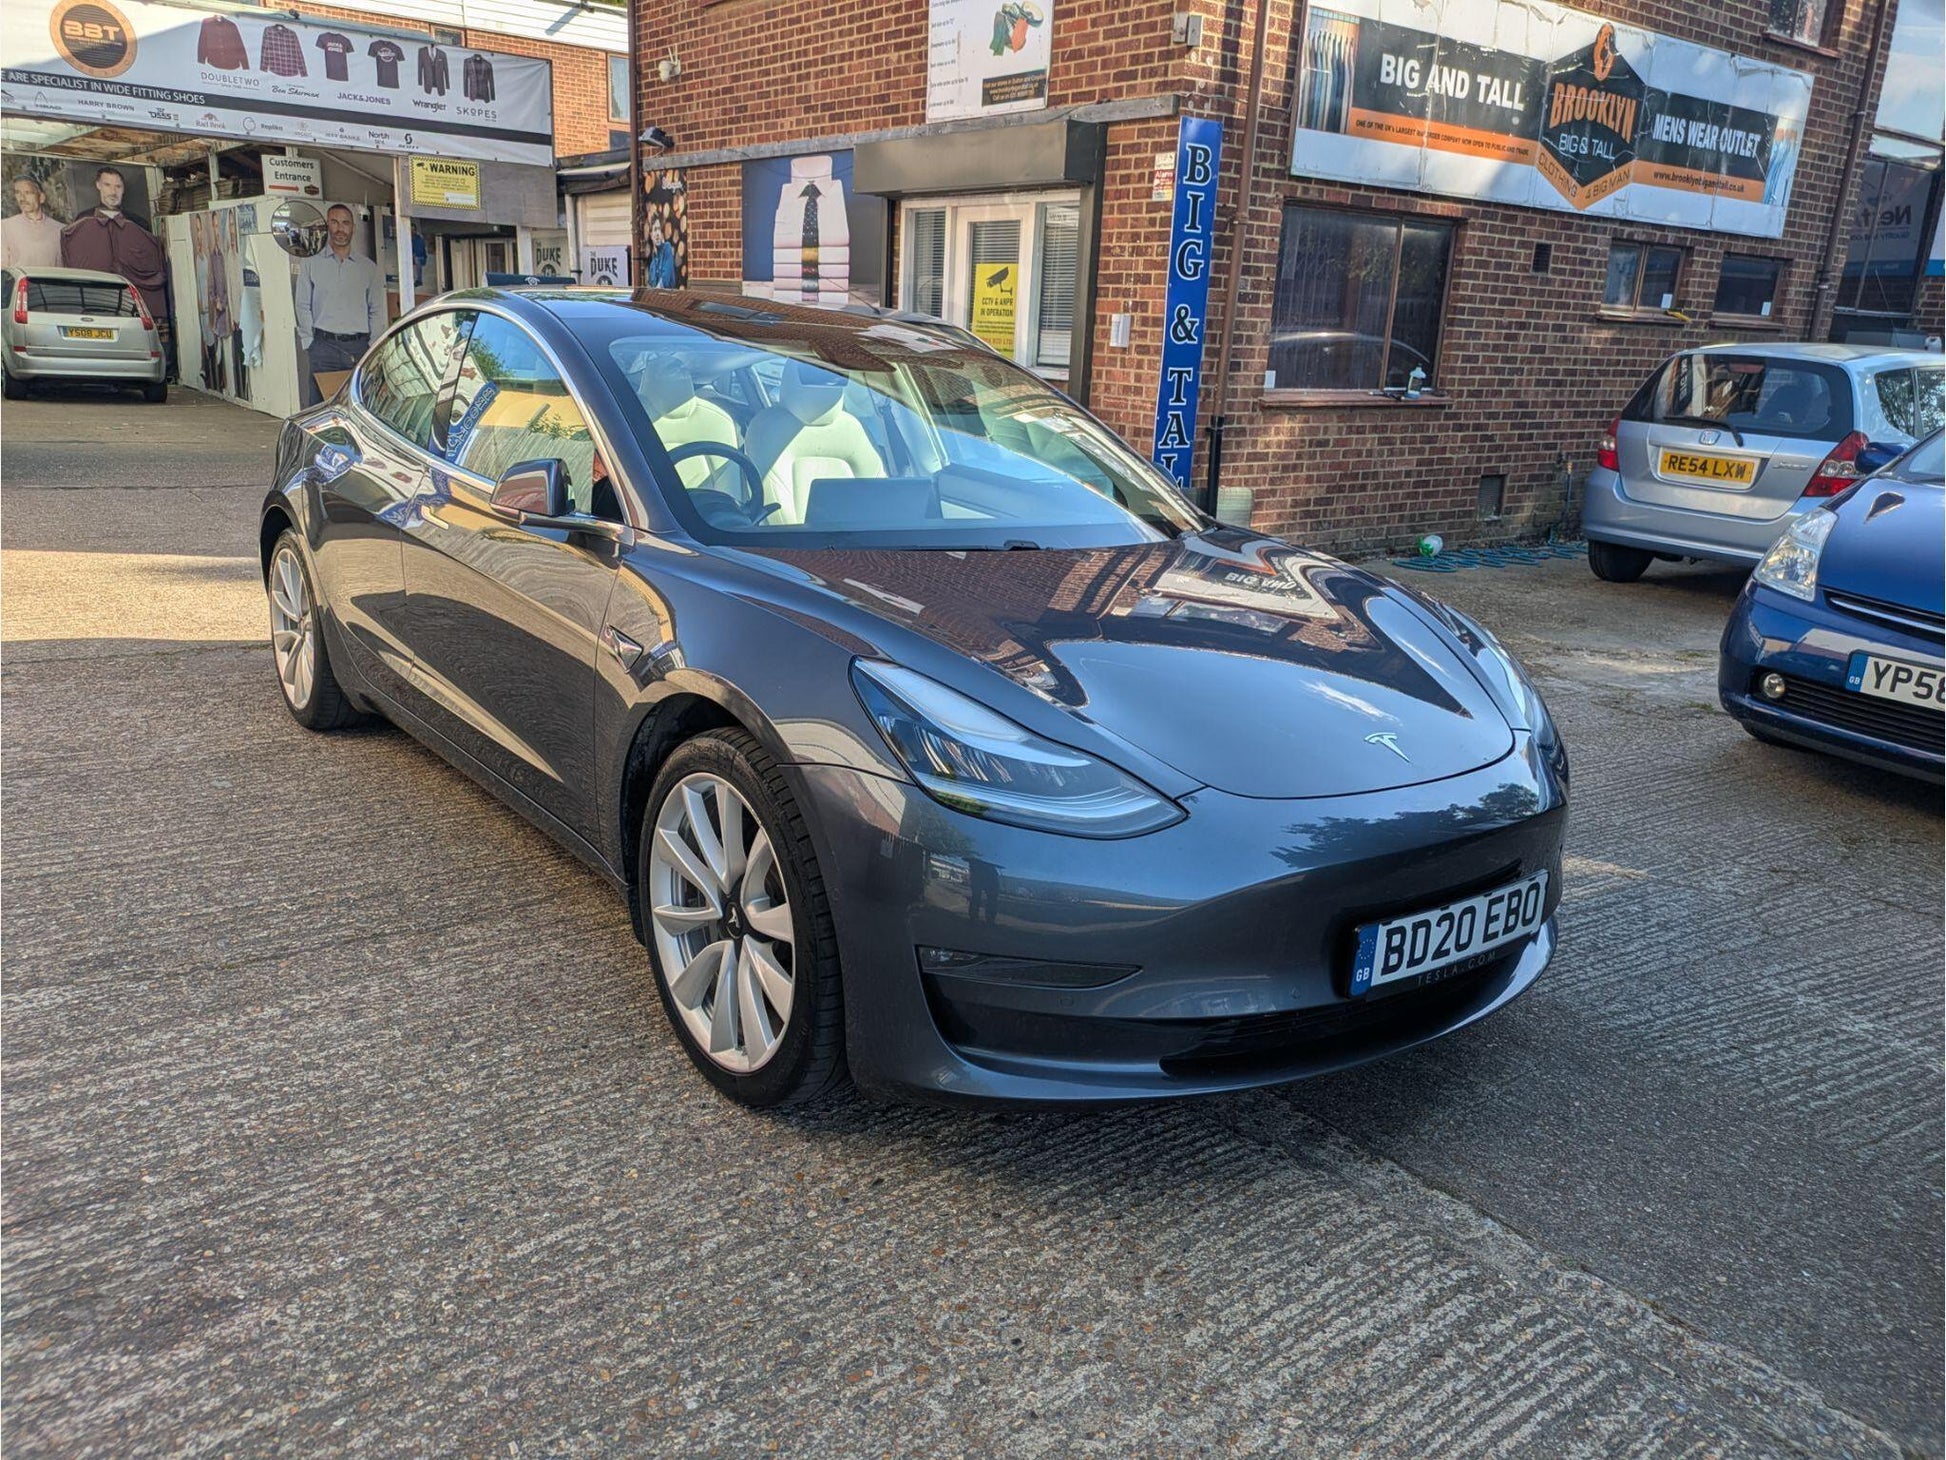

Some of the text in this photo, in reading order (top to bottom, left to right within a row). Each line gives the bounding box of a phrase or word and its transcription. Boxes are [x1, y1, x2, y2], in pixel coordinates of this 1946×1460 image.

[63, 20, 120, 41] BBT
[8, 71, 30, 83] ARE
[30, 74, 89, 90] SPECIALIST
[90, 83, 102, 92] IN
[102, 83, 130, 95] WIDE
[132, 87, 171, 100] FITTING
[173, 91, 205, 105] SHOES
[271, 85, 286, 94] Ben
[1379, 53, 1525, 111] BIG AND TALL
[78, 99, 135, 112] HARRY BROWN
[412, 99, 447, 113] Wrangler
[456, 106, 497, 119] SKOPES
[1549, 82, 1637, 144] BROOKLYN
[368, 130, 390, 140] North
[1652, 113, 1762, 158] MENS WEAR OUTLET
[1591, 138, 1615, 160] TALL
[269, 158, 314, 169] Customers
[430, 162, 475, 177] WARNING
[274, 171, 312, 182] Entrance
[1155, 170, 1173, 178] Alarm
[1537, 152, 1578, 198] CLOTHING
[536, 247, 561, 267] DUKE
[590, 257, 618, 278] DUKE
[982, 297, 993, 306] CCTV
[986, 308, 1014, 317] OPERATION
[1158, 142, 1212, 489] BIG & TAL
[1667, 455, 1747, 480] RE54 LXW
[1849, 675, 1861, 685] GB
[1380, 881, 1541, 977] BD20 EBO
[1355, 967, 1370, 982] GB
[1417, 951, 1497, 986] TESLA.COM
